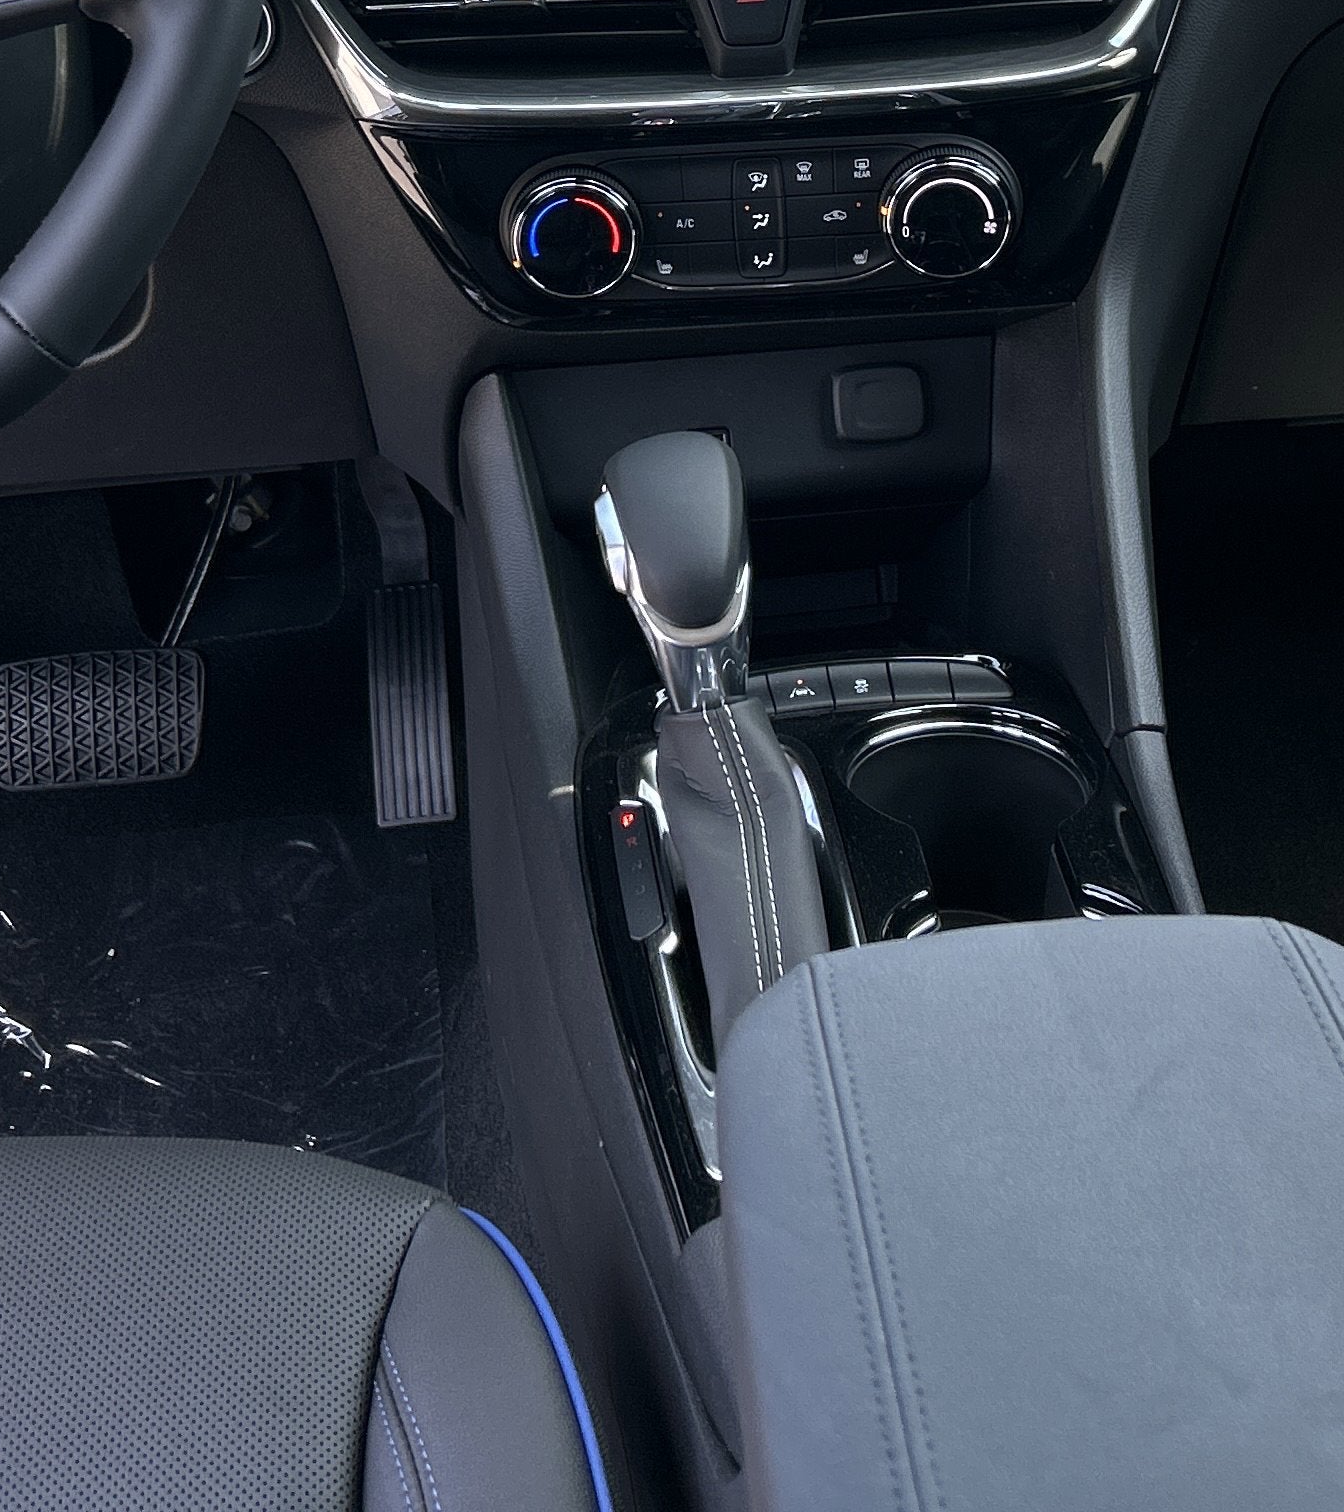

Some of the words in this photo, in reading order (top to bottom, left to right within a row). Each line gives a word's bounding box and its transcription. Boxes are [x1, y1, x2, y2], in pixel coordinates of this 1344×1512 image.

[796, 173, 813, 182] MAX
[853, 170, 871, 179] REAR
[675, 218, 695, 229] A/C
[901, 225, 910, 239] 0
